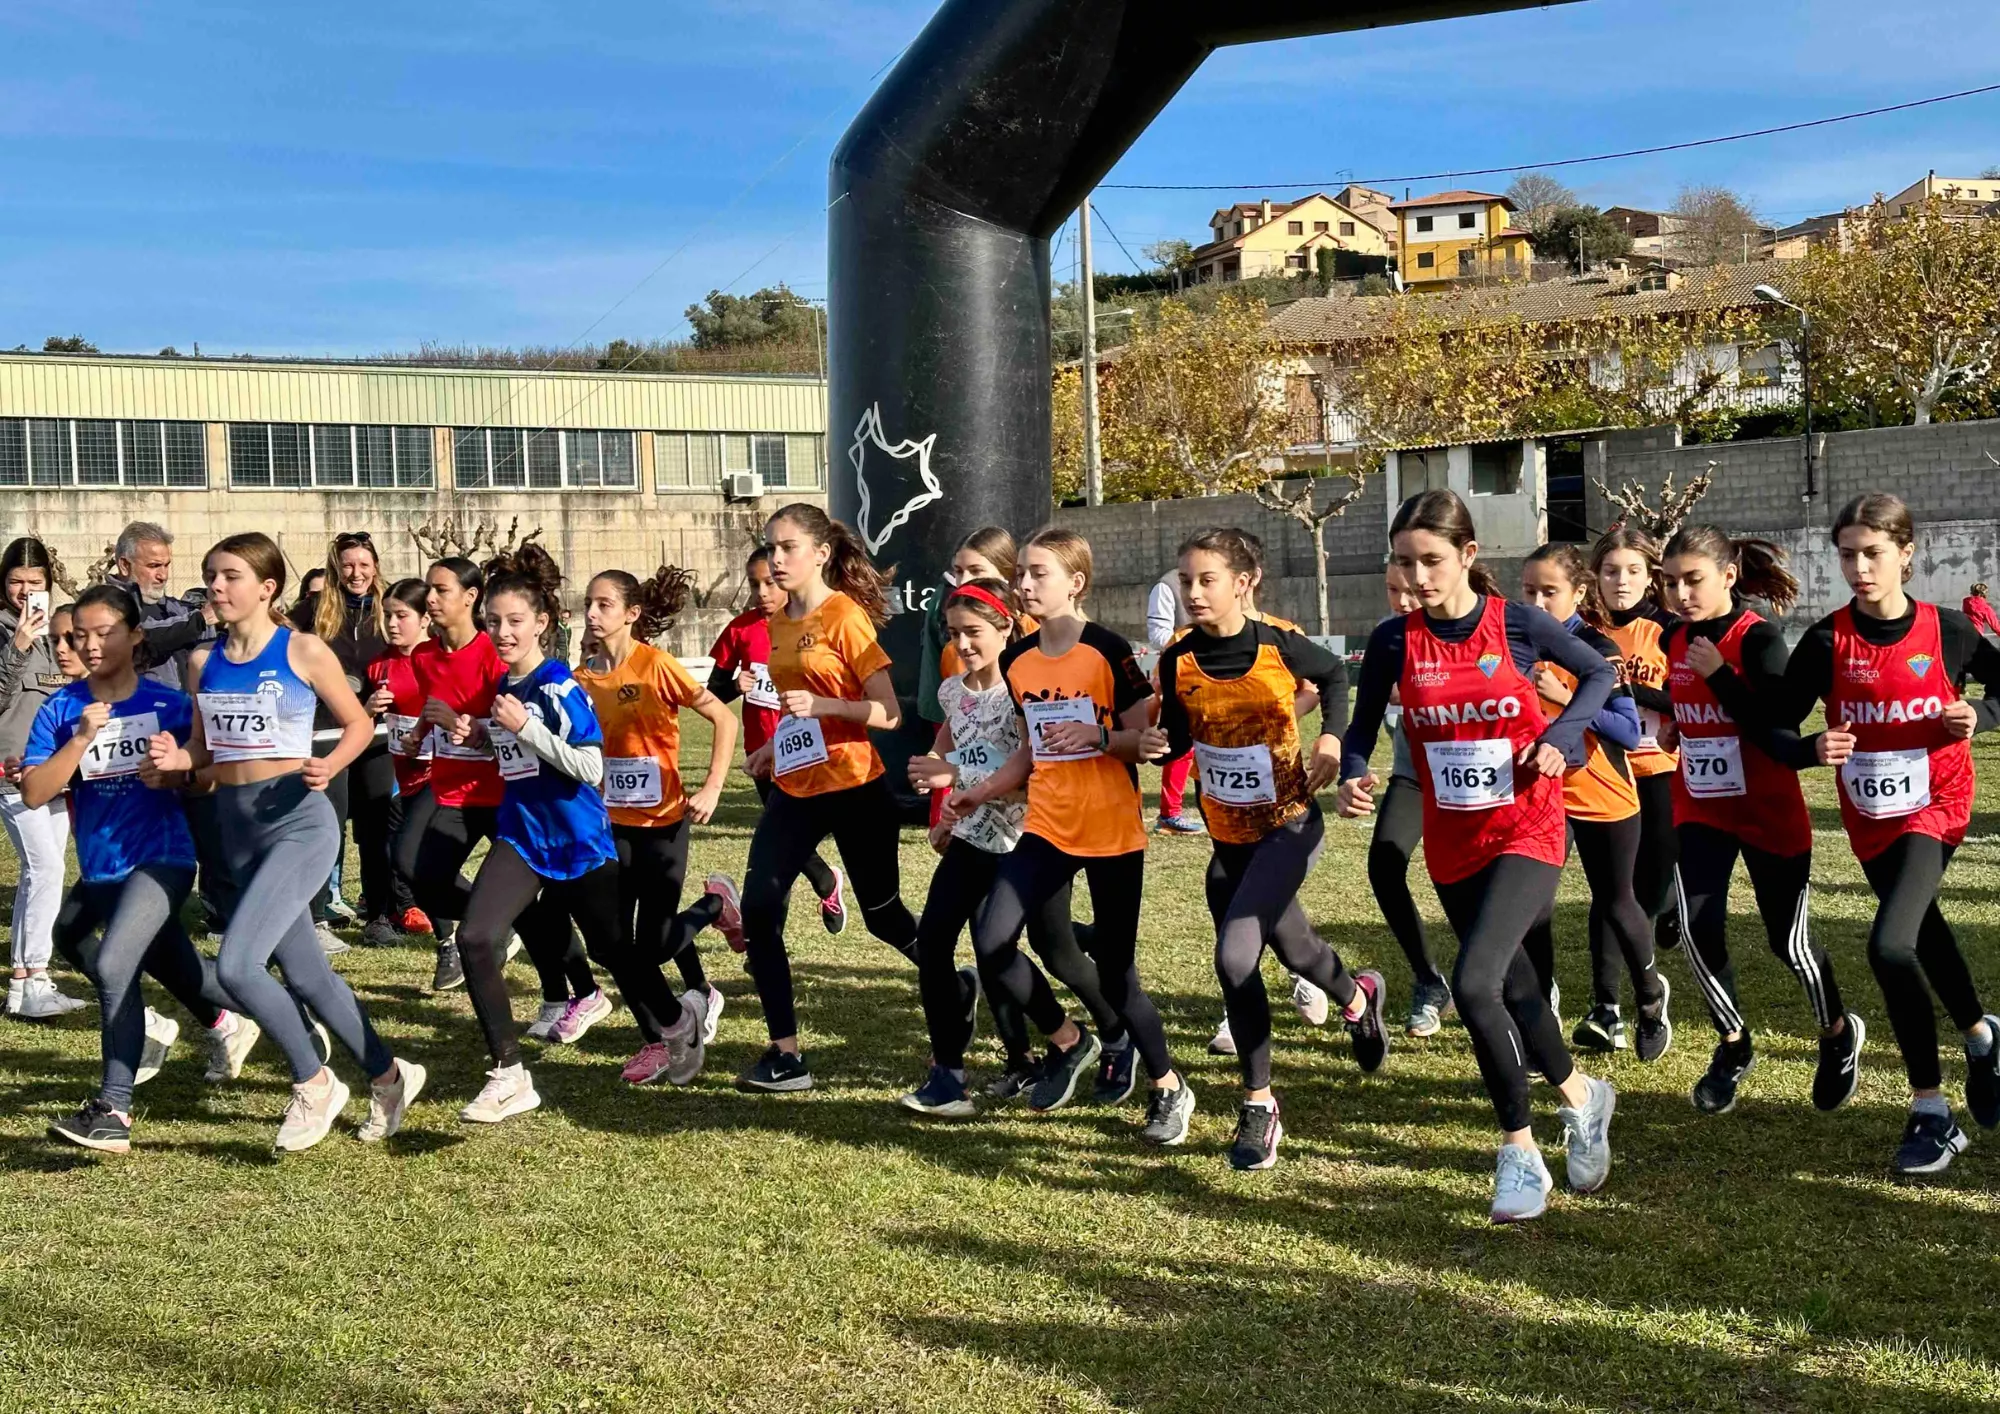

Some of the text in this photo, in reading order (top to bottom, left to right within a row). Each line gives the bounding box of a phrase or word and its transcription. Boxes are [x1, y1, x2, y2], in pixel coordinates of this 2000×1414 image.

[1409, 696, 1520, 728] HINACO
[1840, 696, 1943, 725] HINACO
[211, 714, 266, 732] 1773
[88, 738, 147, 762] 1780
[779, 731, 815, 757] 1698
[609, 774, 650, 789] 1697
[1207, 768, 1261, 789] 1725
[1441, 766, 1498, 788] 1663
[1851, 776, 1911, 798] 1661
